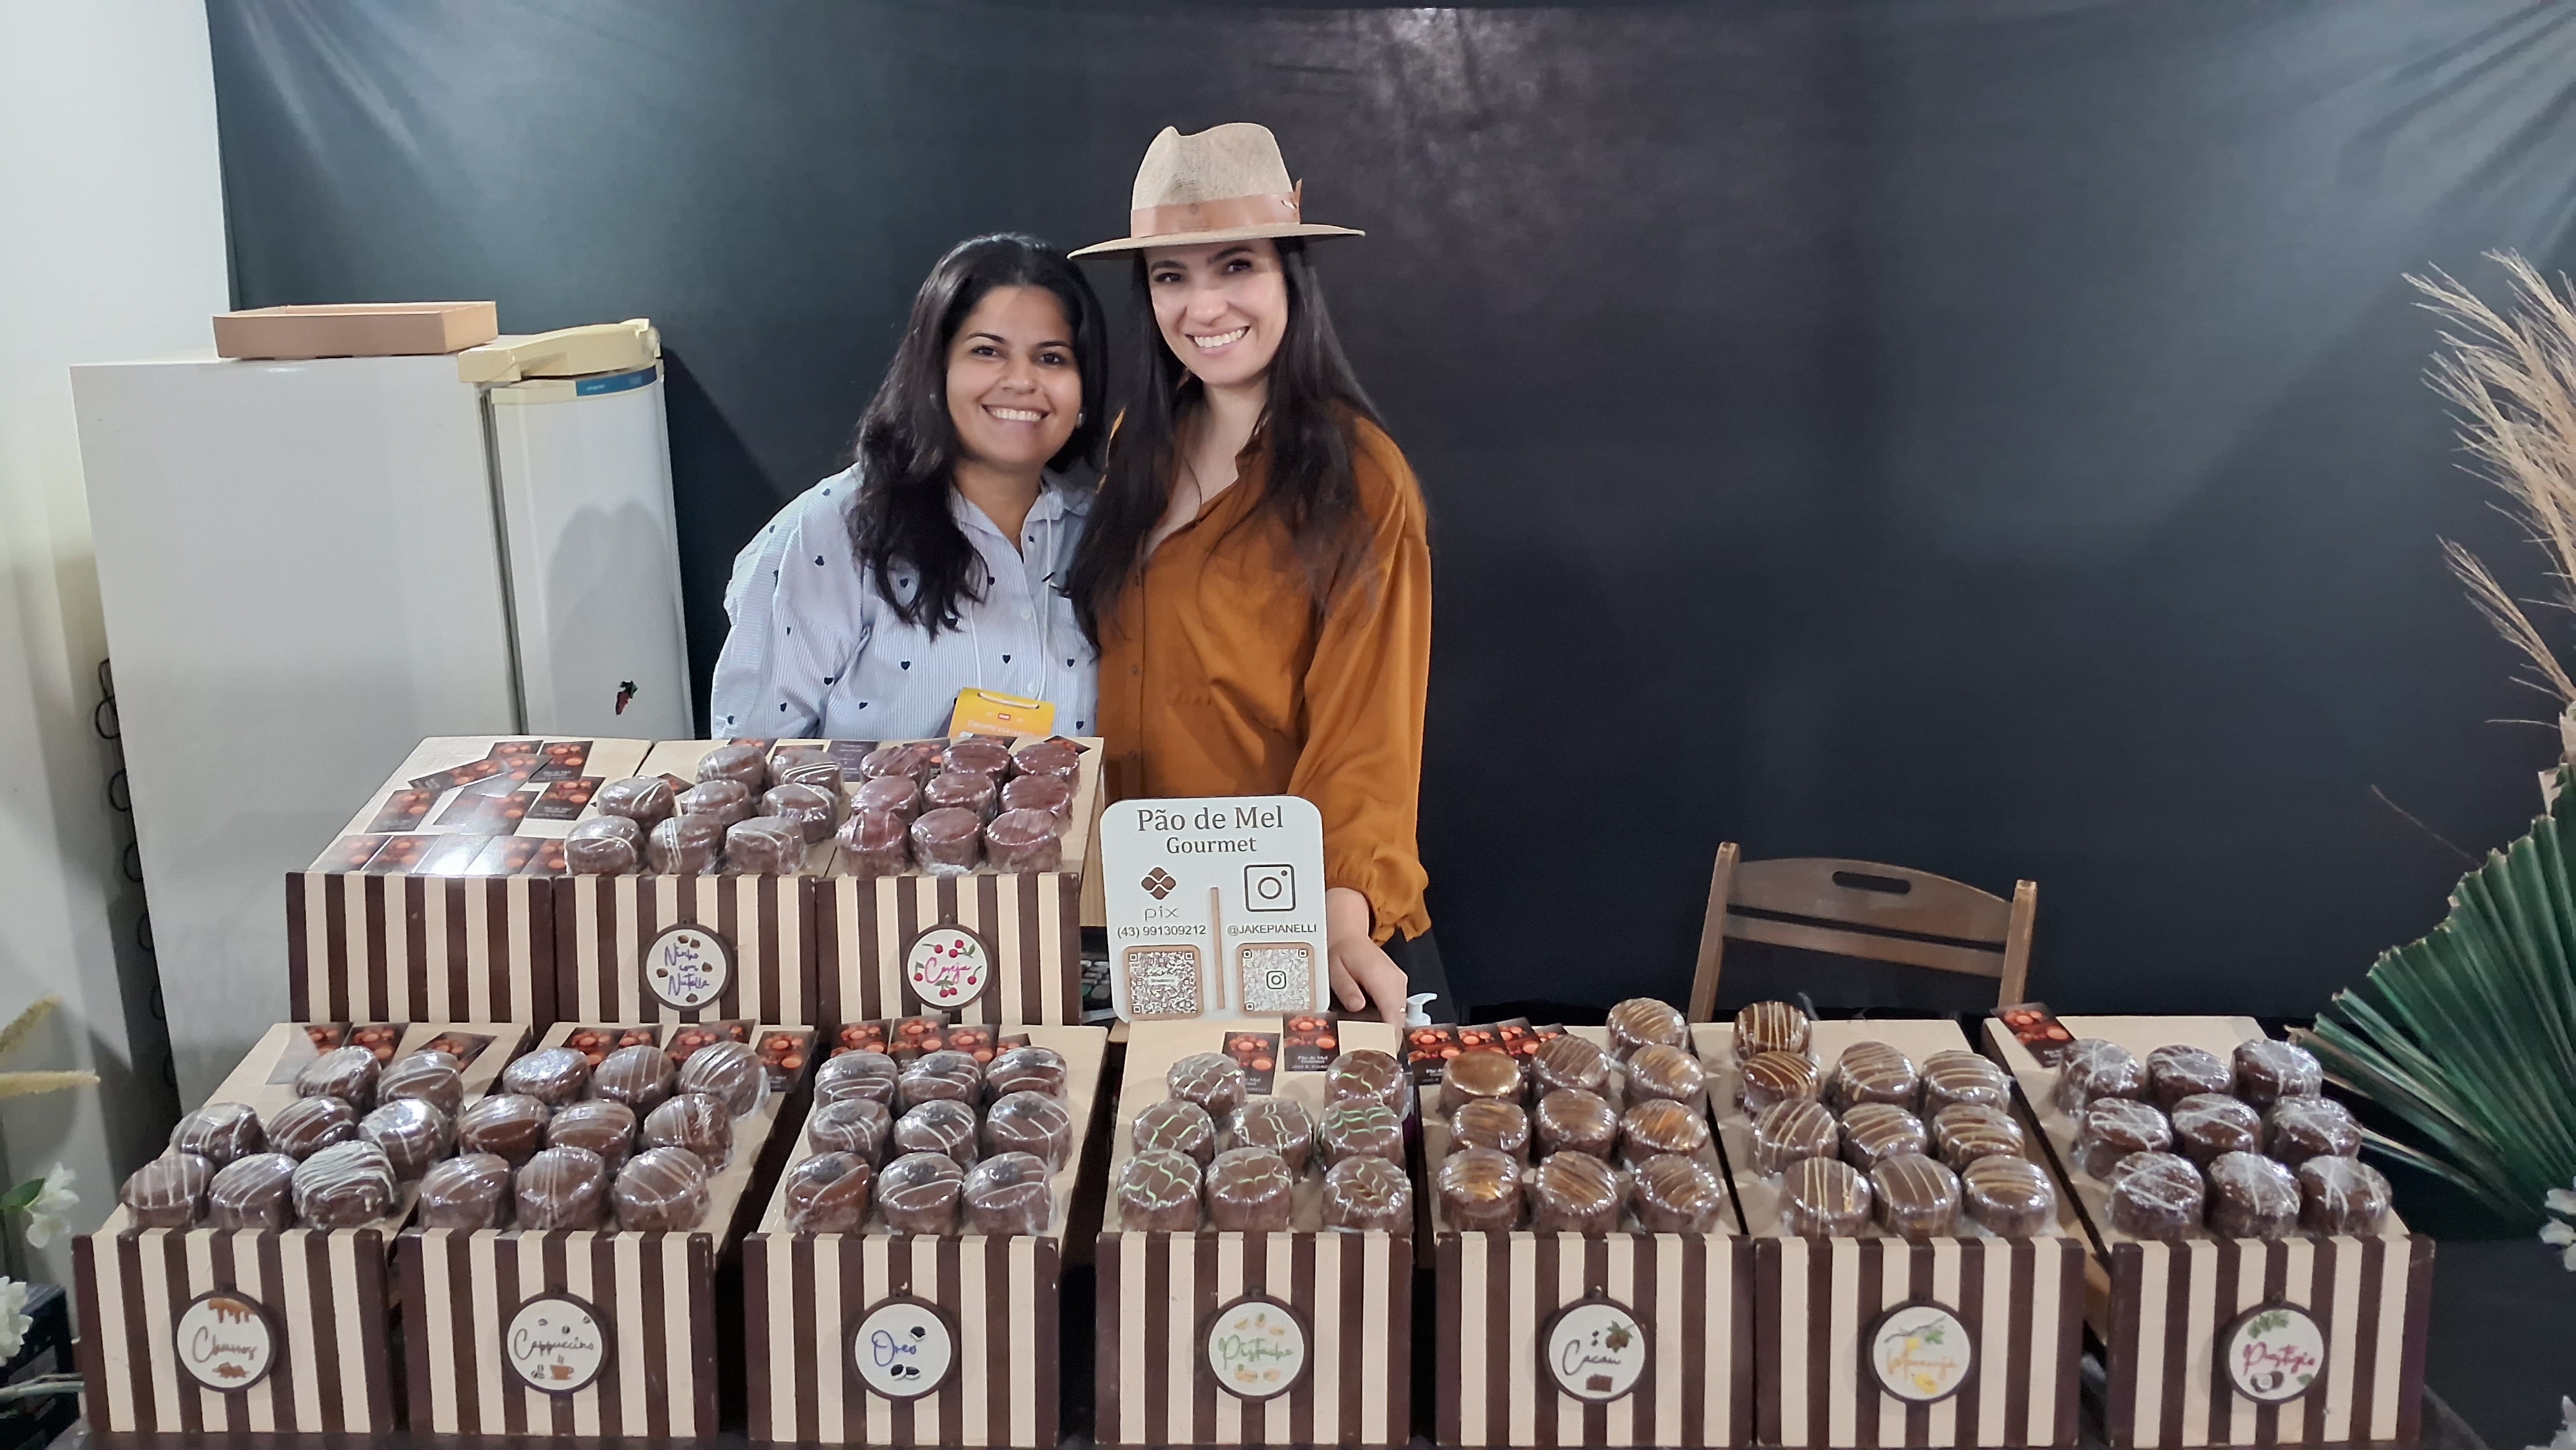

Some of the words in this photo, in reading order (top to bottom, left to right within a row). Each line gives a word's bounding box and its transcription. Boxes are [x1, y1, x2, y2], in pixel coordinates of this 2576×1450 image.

[1136, 809, 1185, 831] Pão
[1195, 808, 1226, 830] de
[1235, 805, 1284, 829] Mel
[1167, 837, 1257, 854] Gourmet
[1145, 906, 1179, 921] pix
[1118, 926, 1140, 938] (43)
[1143, 925, 1207, 936] 991309212
[1227, 924, 1317, 936] @JAKEPIANELLI
[514, 1328, 594, 1360] Cappuccino
[871, 1329, 917, 1367] Oreo
[1562, 1339, 1621, 1376] Cacau
